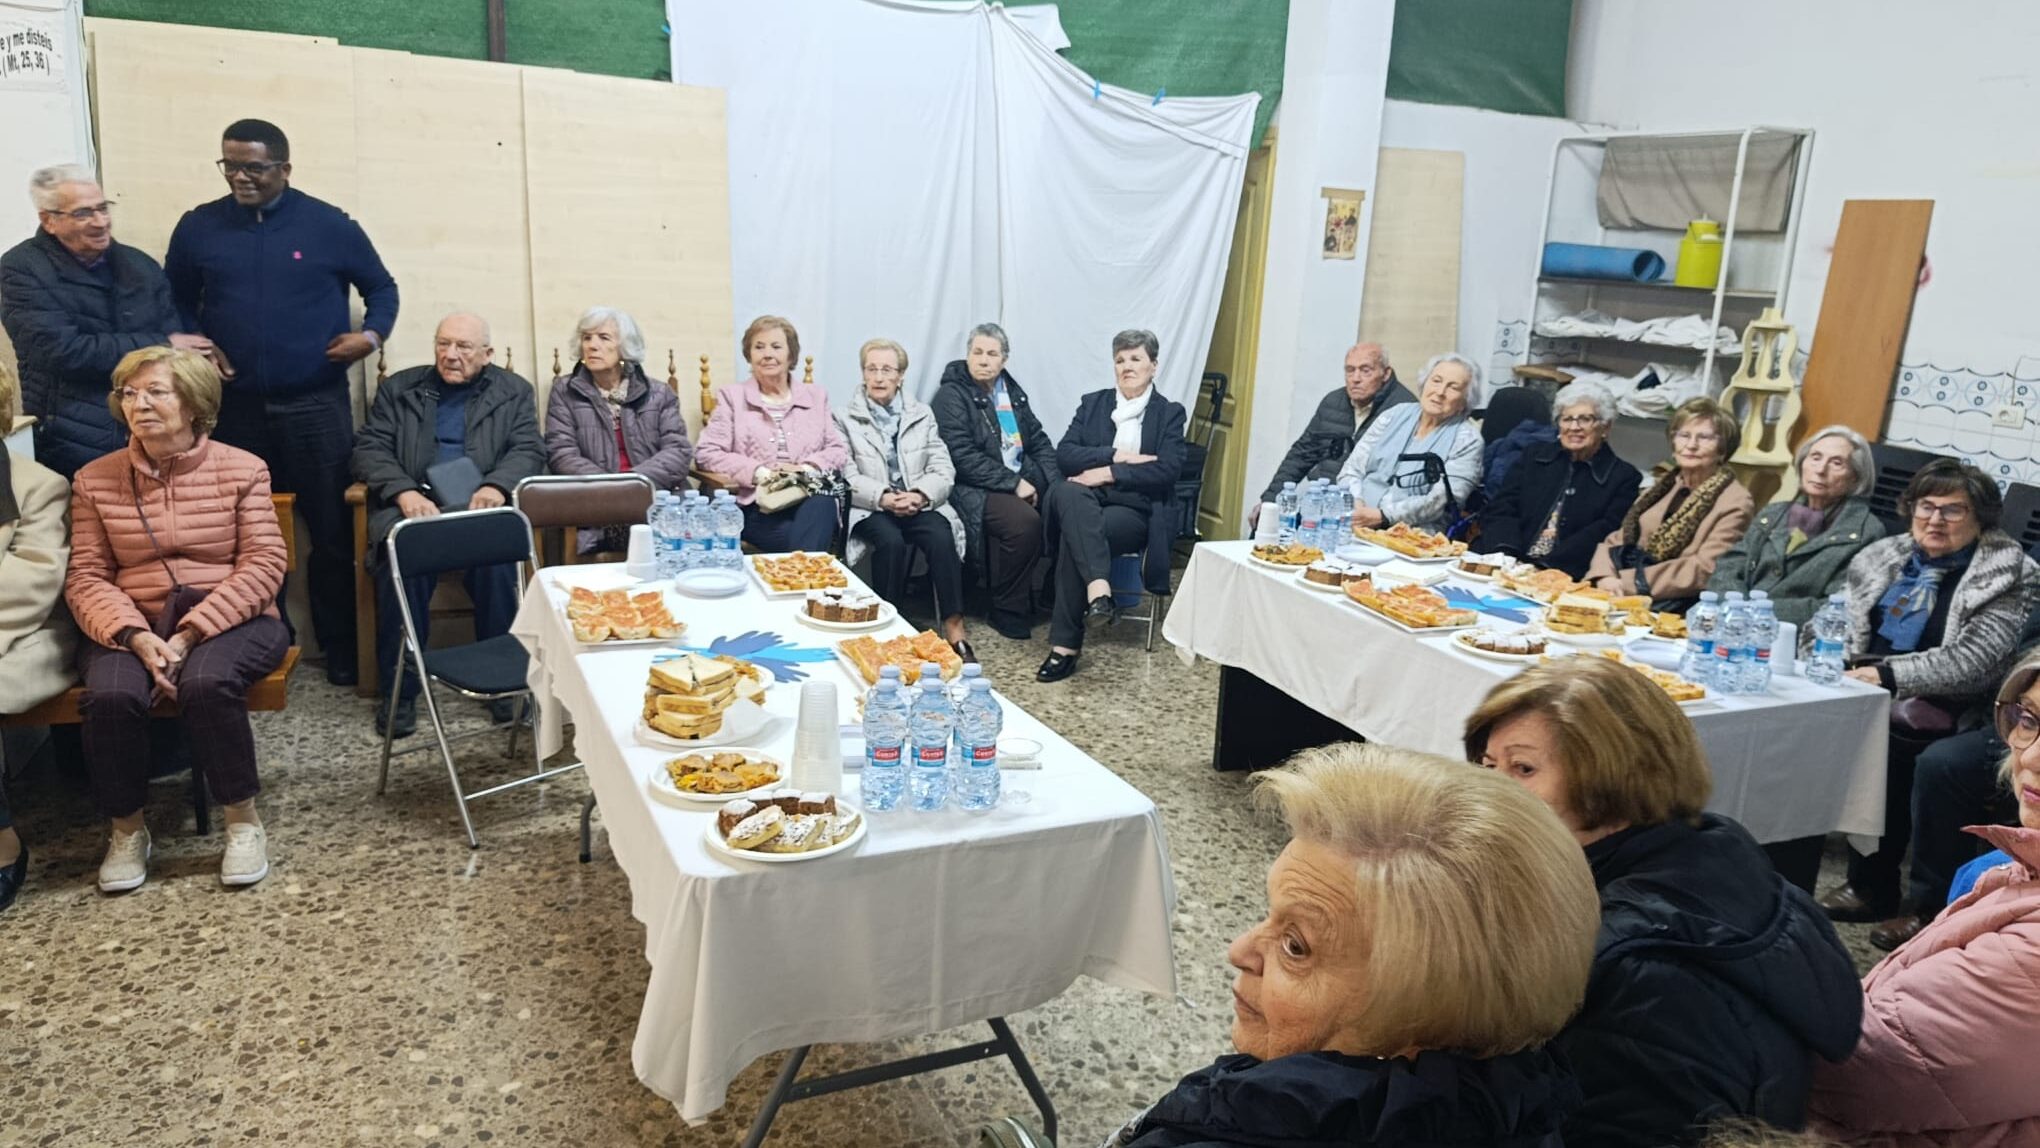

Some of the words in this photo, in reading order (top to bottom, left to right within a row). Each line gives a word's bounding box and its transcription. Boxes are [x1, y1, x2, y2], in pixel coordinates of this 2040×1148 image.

[6, 35, 11, 53] y
[13, 32, 25, 47] me
[26, 27, 53, 51] disteis
